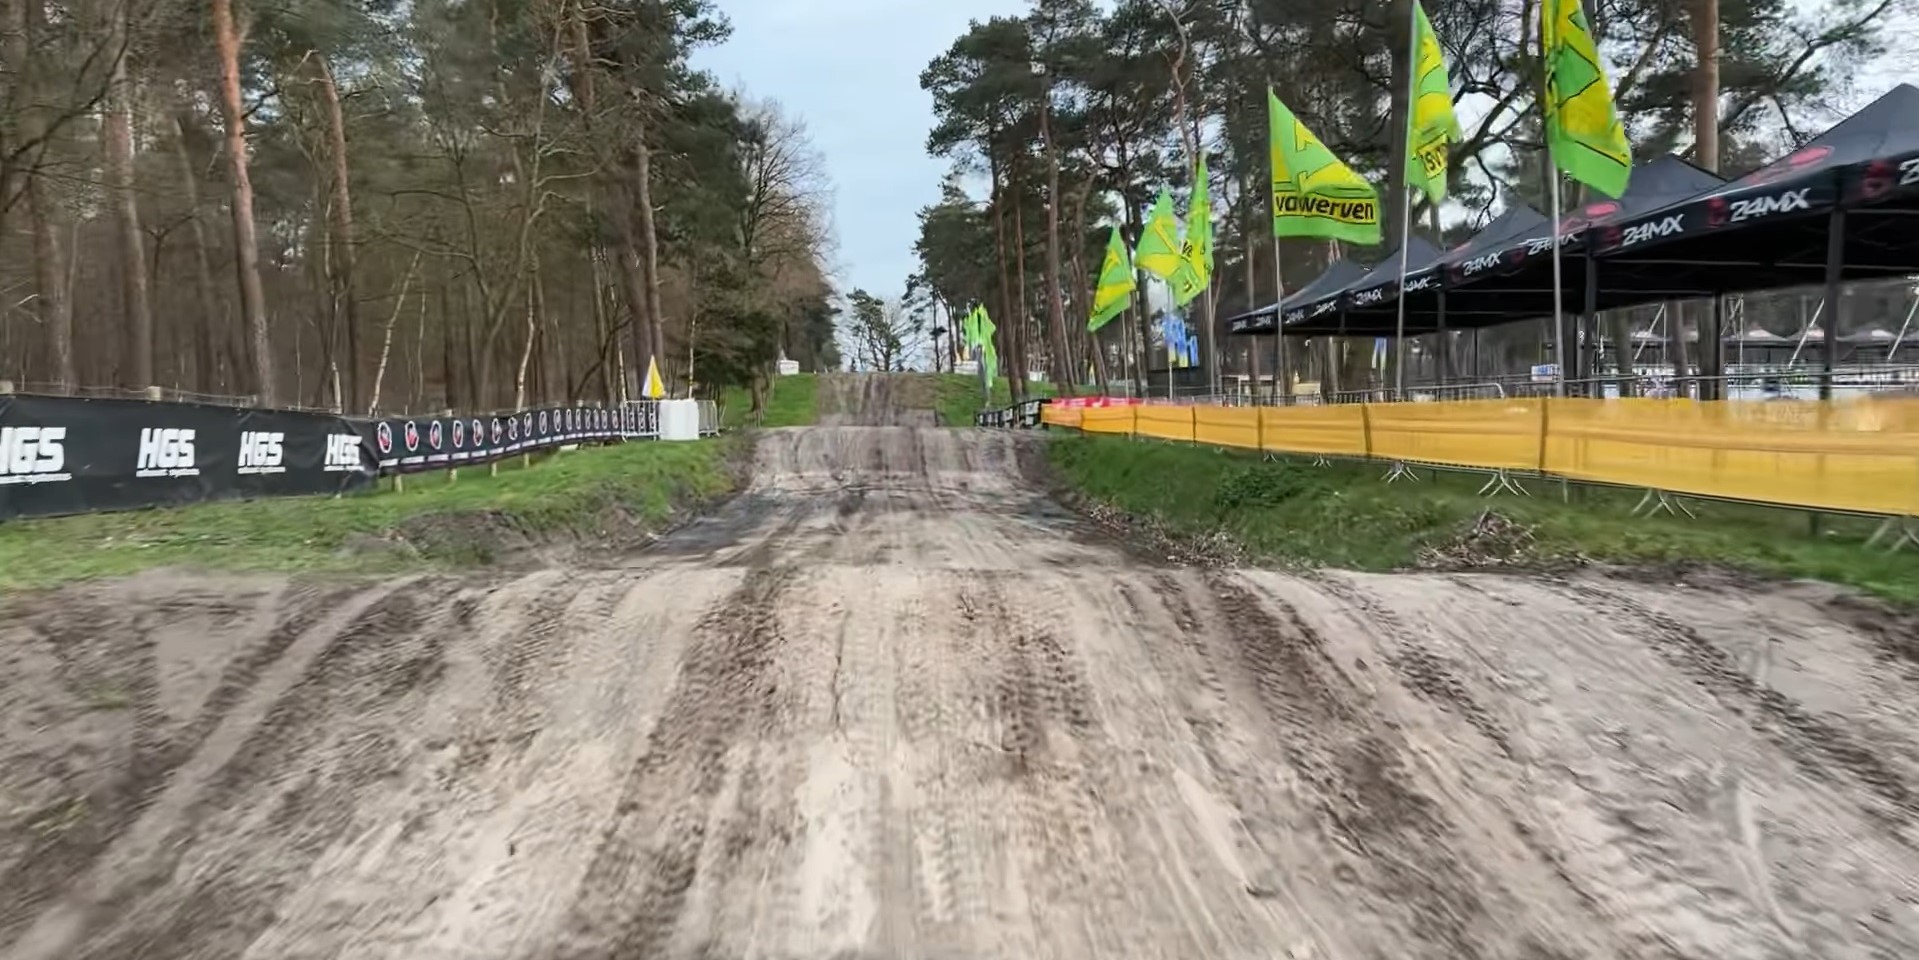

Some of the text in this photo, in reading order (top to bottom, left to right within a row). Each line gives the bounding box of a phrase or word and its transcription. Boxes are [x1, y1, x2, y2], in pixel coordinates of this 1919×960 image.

[1729, 187, 1811, 222] 24MX
[1622, 213, 1685, 247] 24MX
[1462, 250, 1503, 276] 24MX
[137, 428, 196, 469] HGS
[238, 431, 285, 466] HGS
